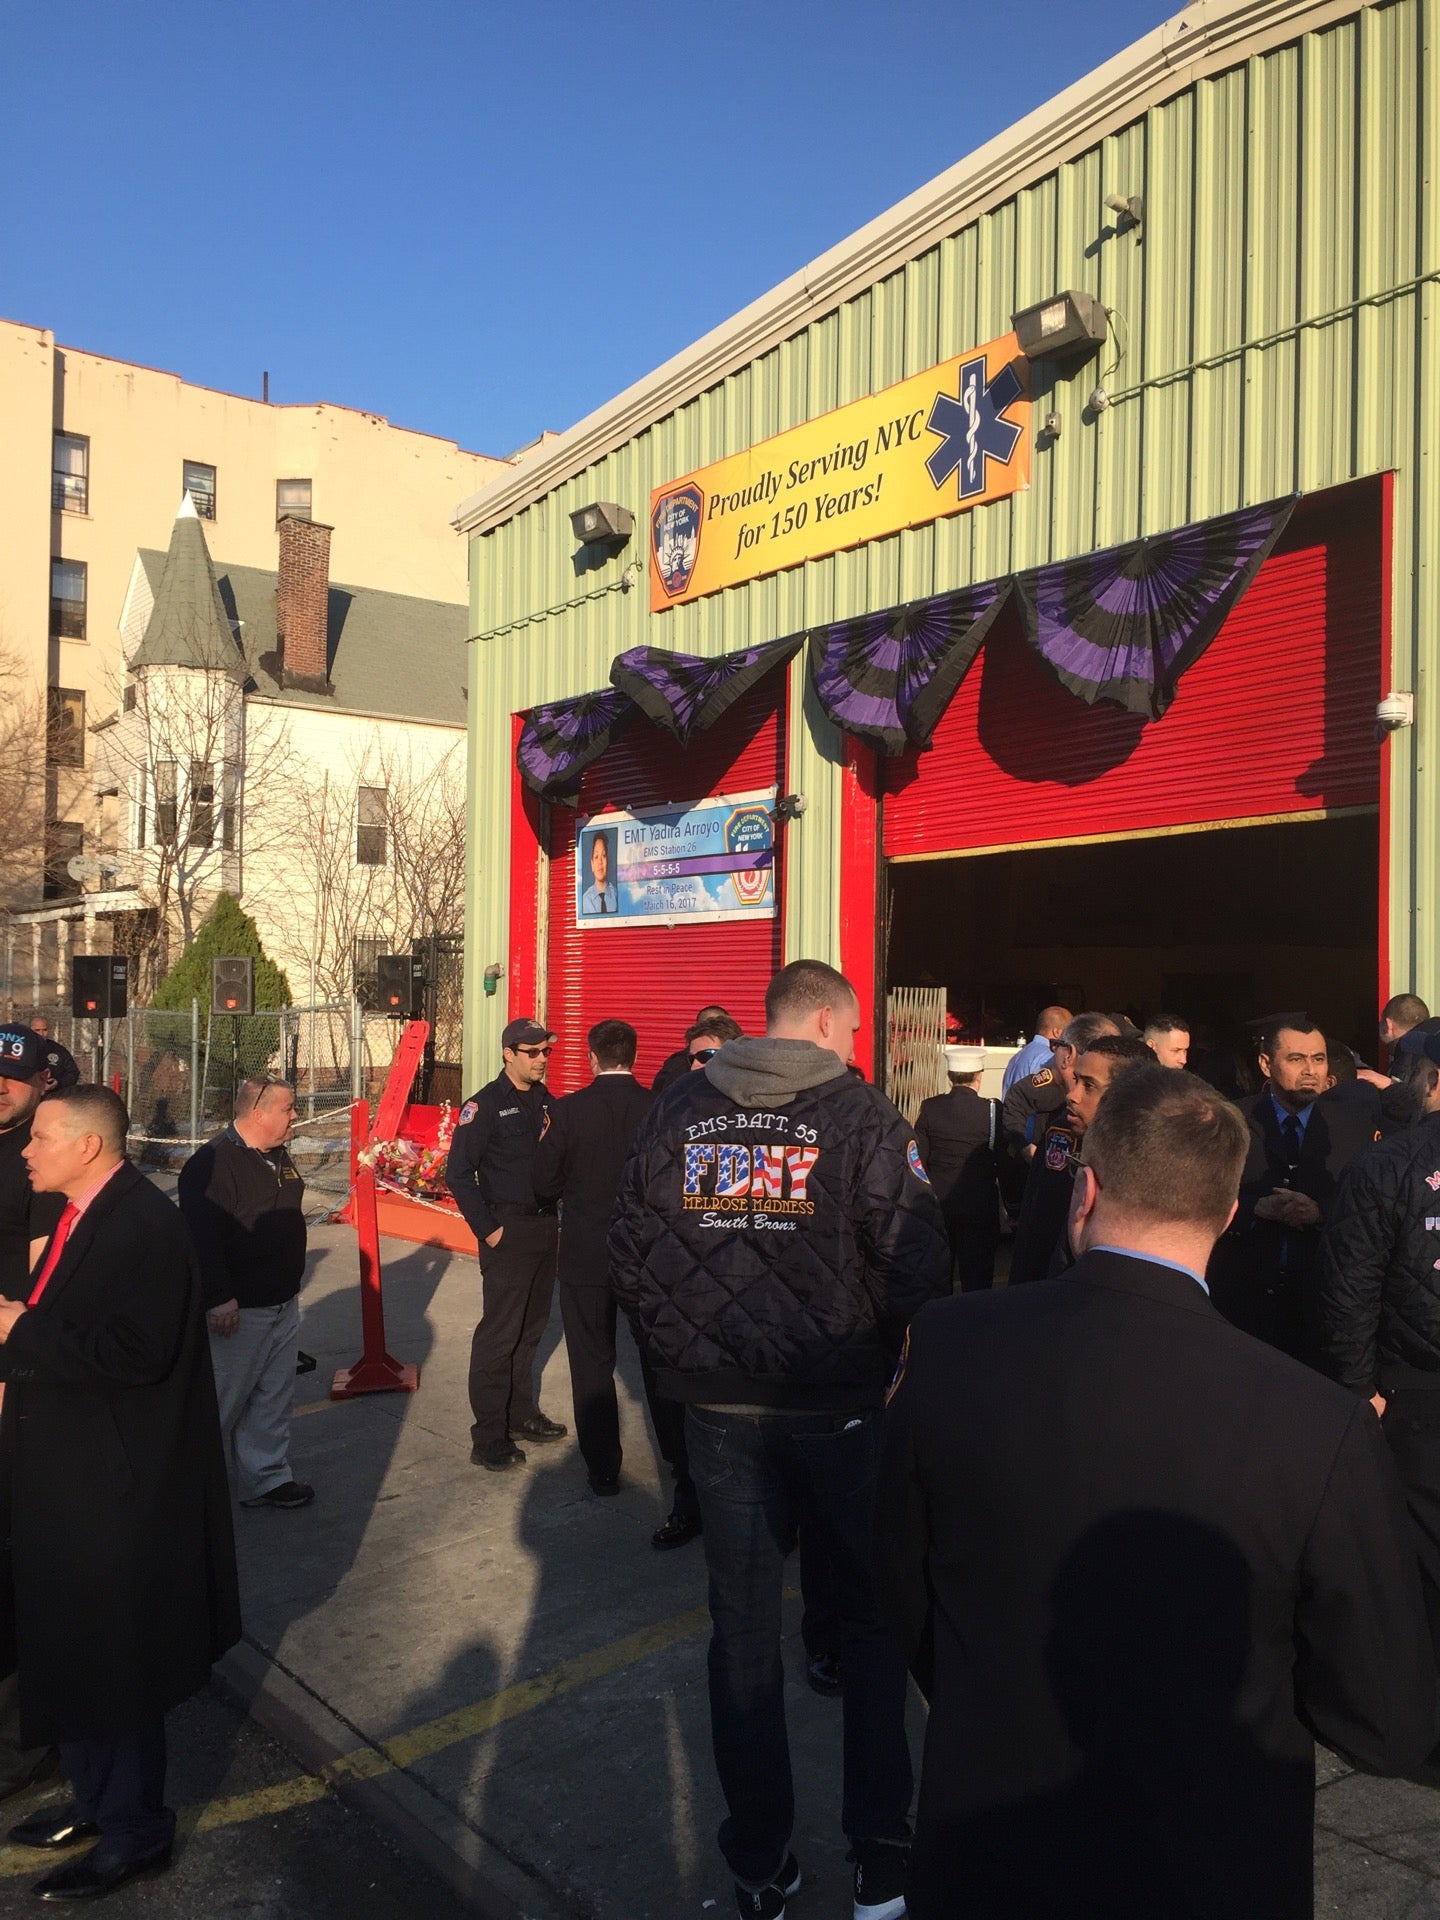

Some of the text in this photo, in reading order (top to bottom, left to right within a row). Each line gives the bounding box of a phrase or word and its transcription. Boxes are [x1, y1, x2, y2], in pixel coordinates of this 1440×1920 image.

[708, 409, 925, 520] Proudly Serving NYC
[668, 509, 685, 522] CITY OF
[735, 473, 883, 560] for 150 Years!
[624, 820, 720, 844] EMT Yadira Arroyo
[731, 821, 742, 837] FIRE
[751, 832, 763, 840] YORK
[643, 841, 697, 858] EMS Station 26
[653, 862, 680, 876] 5-5-5-5
[646, 884, 661, 896] Rest
[671, 883, 693, 894] Peace
[679, 897, 697, 908] 2017
[686, 1113, 818, 1144] EMS-BATT. 55
[683, 1143, 820, 1200] FDNY
[683, 1197, 815, 1215] MELROSE MADNESS
[699, 1211, 797, 1231] South Bronx
